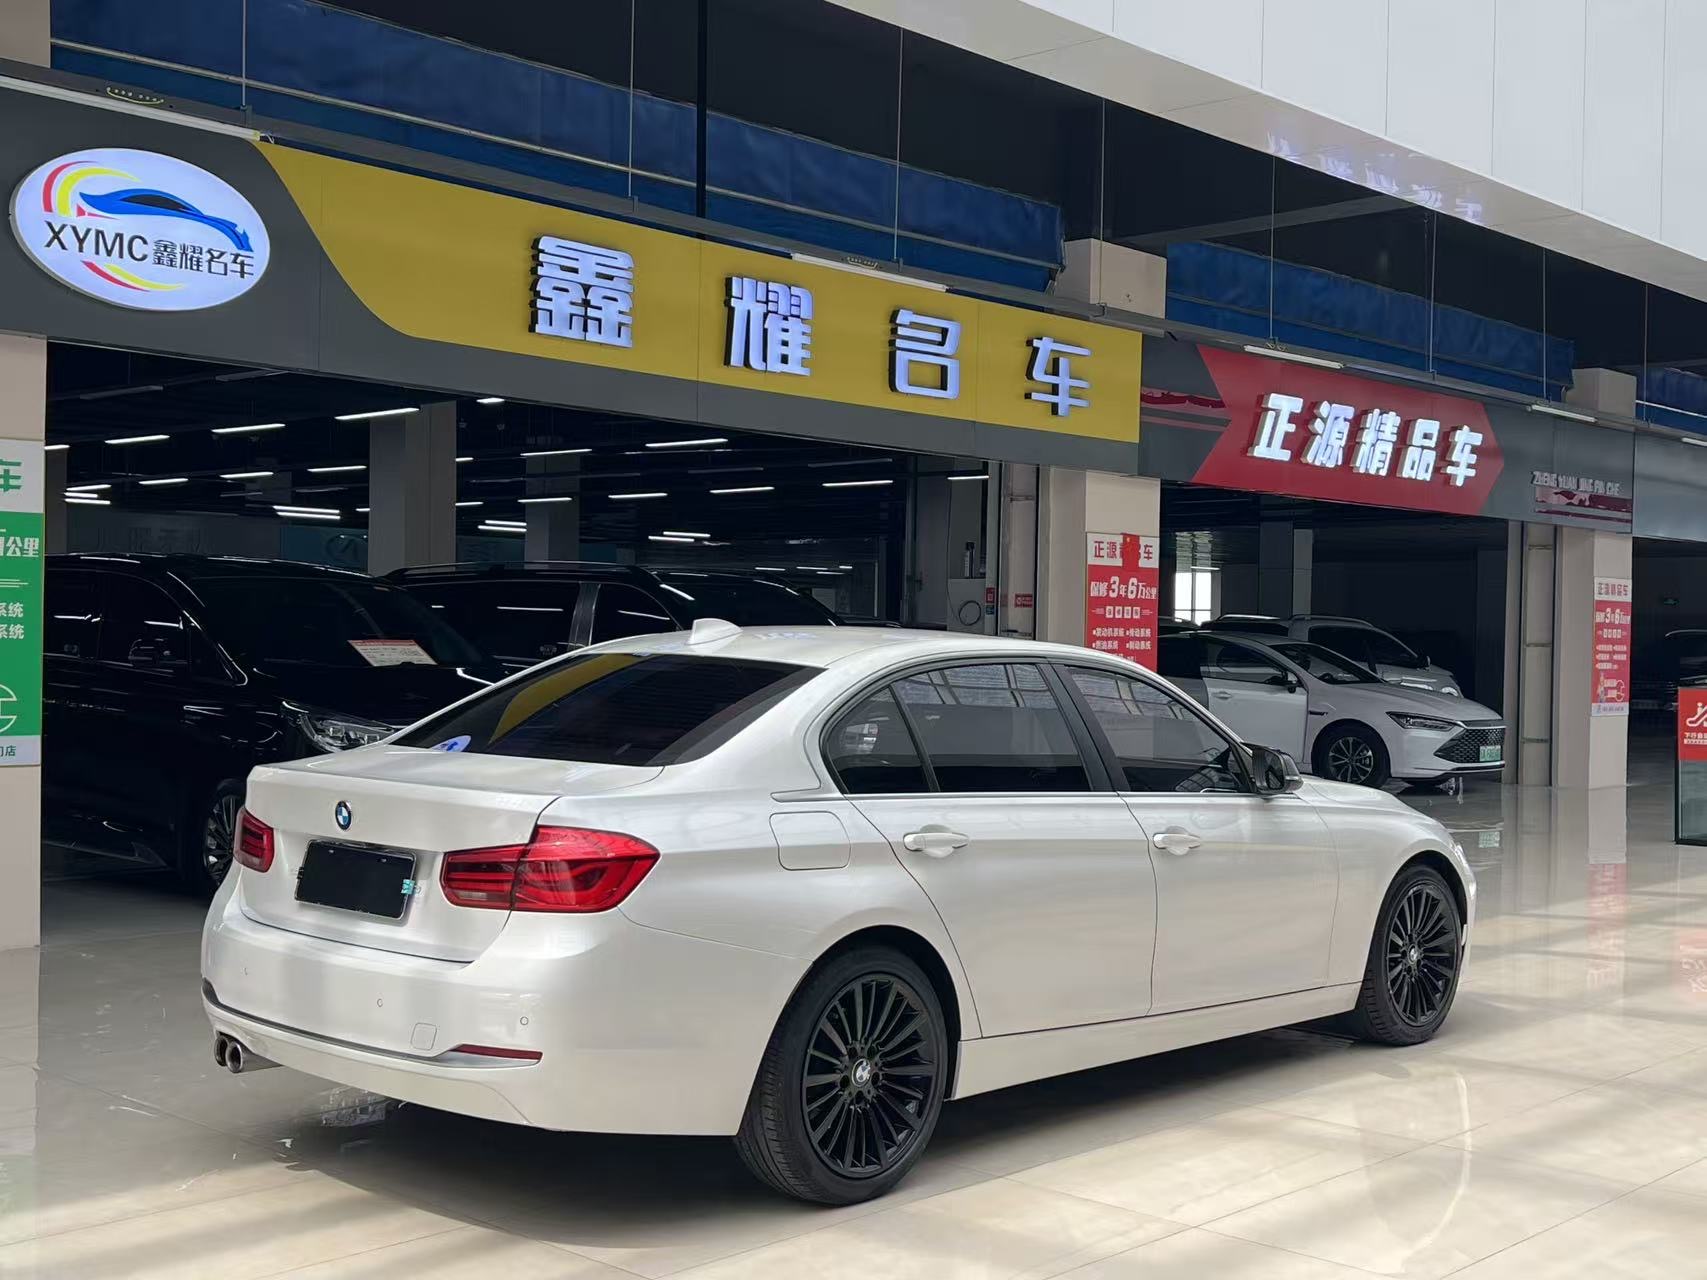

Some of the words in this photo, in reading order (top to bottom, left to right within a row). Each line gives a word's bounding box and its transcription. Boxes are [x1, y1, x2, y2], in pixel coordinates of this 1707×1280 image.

[43, 220, 149, 263] XYMC
[153, 239, 255, 280] 鑫耀名车
[529, 235, 1091, 417] 鑫耀名车
[1247, 392, 1483, 487] 正源精品车
[1094, 540, 1153, 561] 正源车
